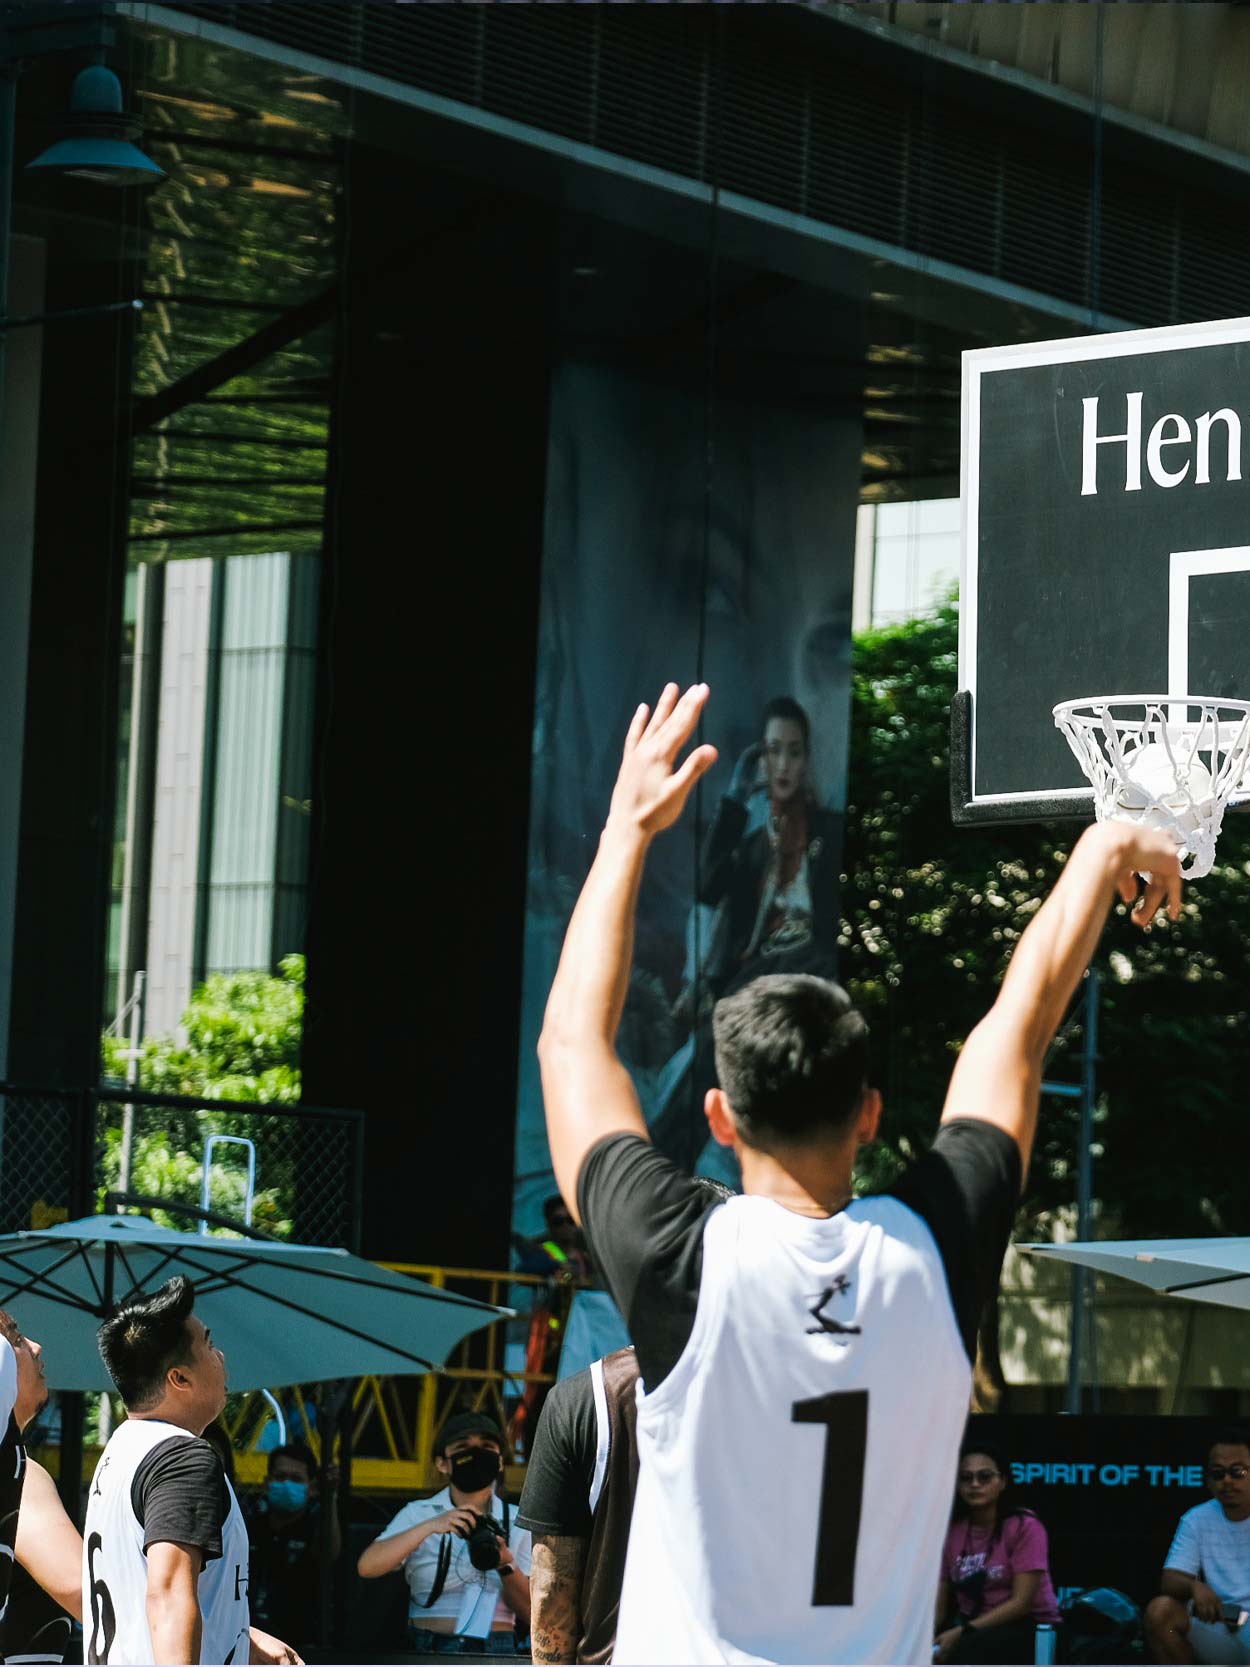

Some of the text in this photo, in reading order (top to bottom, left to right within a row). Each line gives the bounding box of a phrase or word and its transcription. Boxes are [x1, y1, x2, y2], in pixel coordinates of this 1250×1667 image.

[791, 1389, 869, 1607] 1
[1010, 1462, 1204, 1488] SPIRIT OF THE
